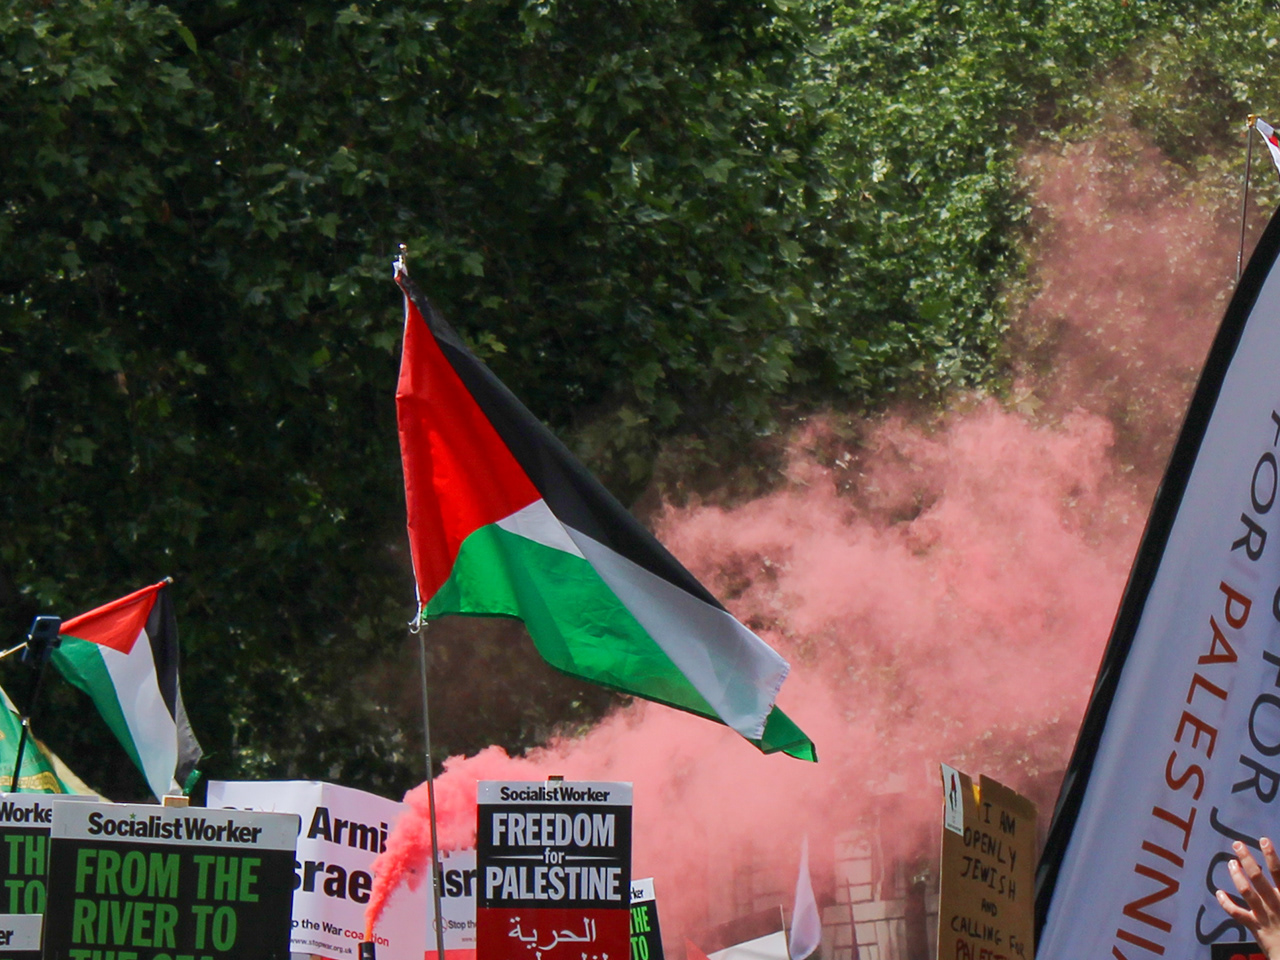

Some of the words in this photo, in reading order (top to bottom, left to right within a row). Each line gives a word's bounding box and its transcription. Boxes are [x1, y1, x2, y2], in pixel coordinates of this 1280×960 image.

[307, 807, 389, 853] Armi
[492, 812, 615, 847] FREEDOM
[983, 802, 993, 824] I
[999, 810, 1016, 837] AM
[4, 835, 46, 876] TH
[544, 847, 564, 864] for
[963, 826, 1017, 874] OPENLY
[75, 849, 180, 899] FROM
[193, 856, 262, 902] THE
[486, 866, 621, 901] PALESTINE
[960, 855, 1017, 900] JEWISH
[4, 880, 47, 915] TO
[980, 897, 998, 918] AND
[72, 899, 179, 950] RIVER
[191, 905, 237, 951] TO
[302, 919, 321, 931] the
[322, 921, 343, 936] War
[344, 928, 390, 947] coation
[508, 916, 596, 950] الحرية
[950, 915, 1003, 946] CALLING
